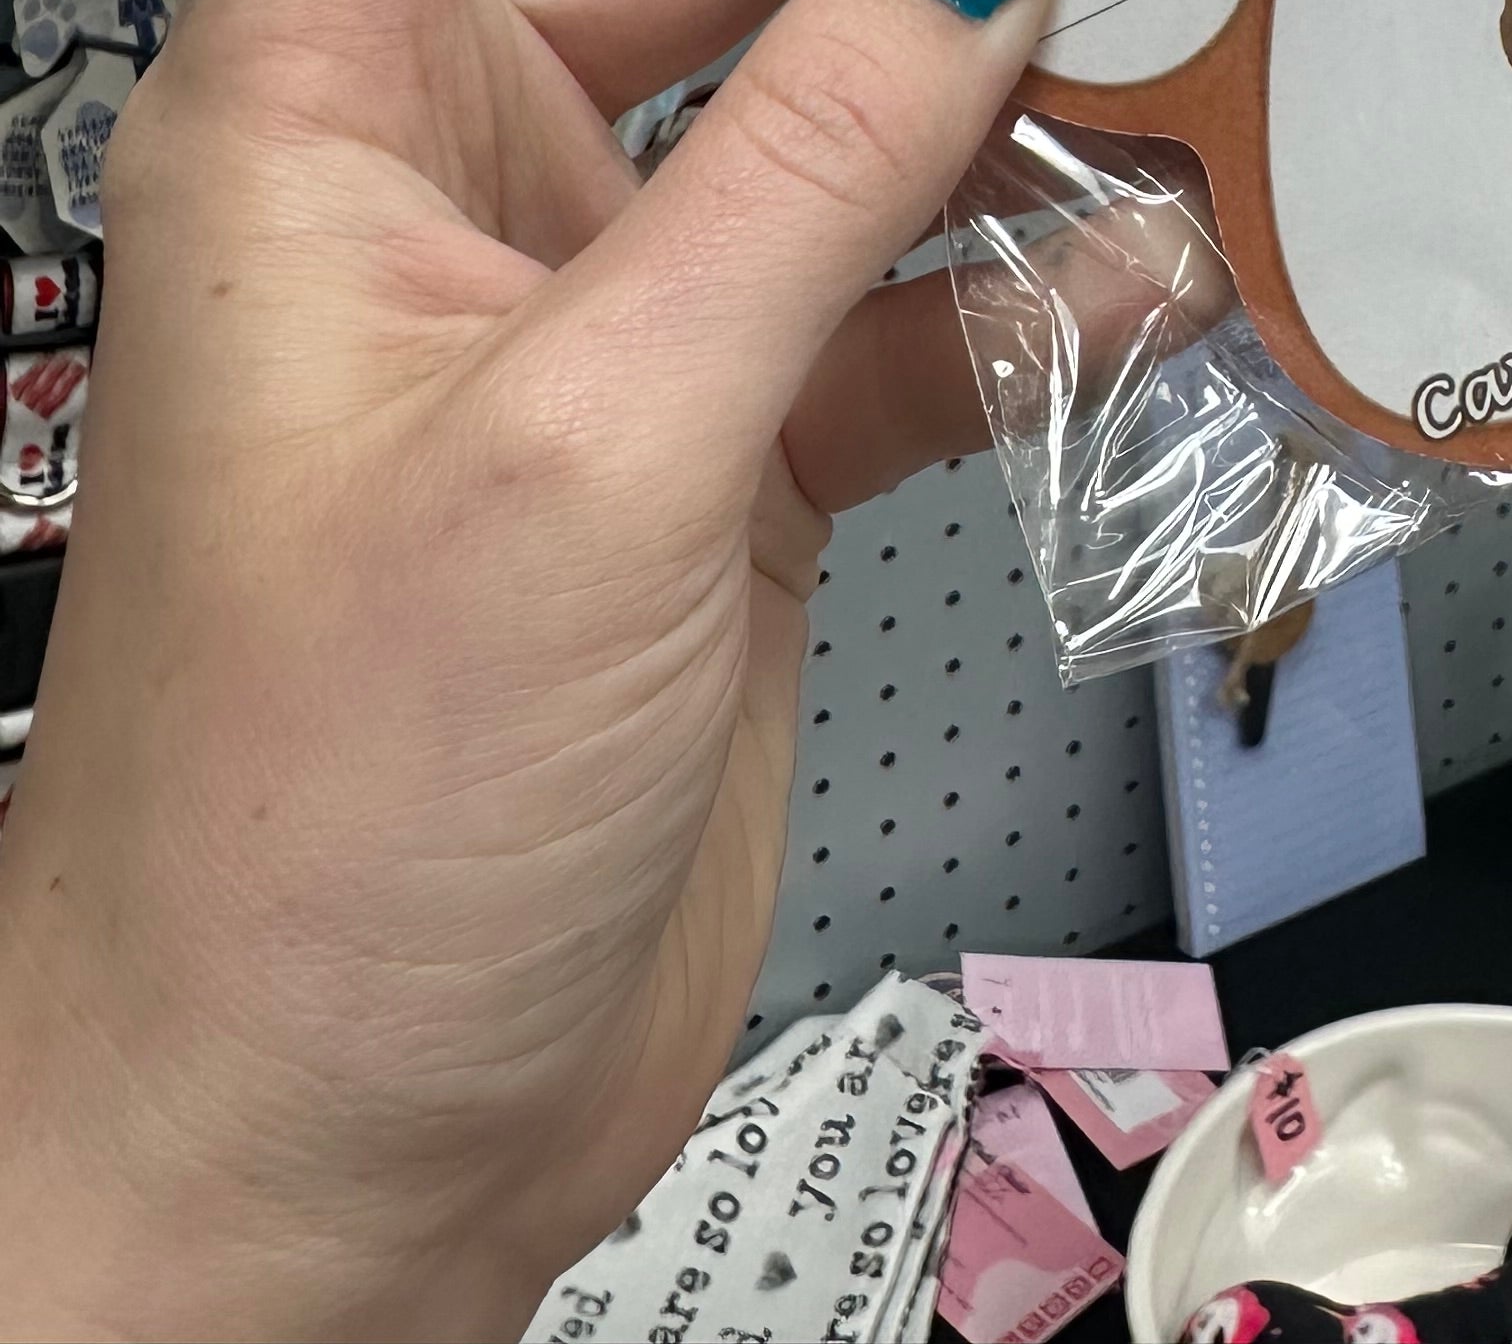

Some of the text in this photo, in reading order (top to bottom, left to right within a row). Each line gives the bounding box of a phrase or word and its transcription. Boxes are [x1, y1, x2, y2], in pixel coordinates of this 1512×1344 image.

[787, 1037, 880, 1221] you ar
[694, 1191, 740, 1254] so
[820, 1091, 938, 1344] re so love
[556, 1285, 614, 1339] ed
